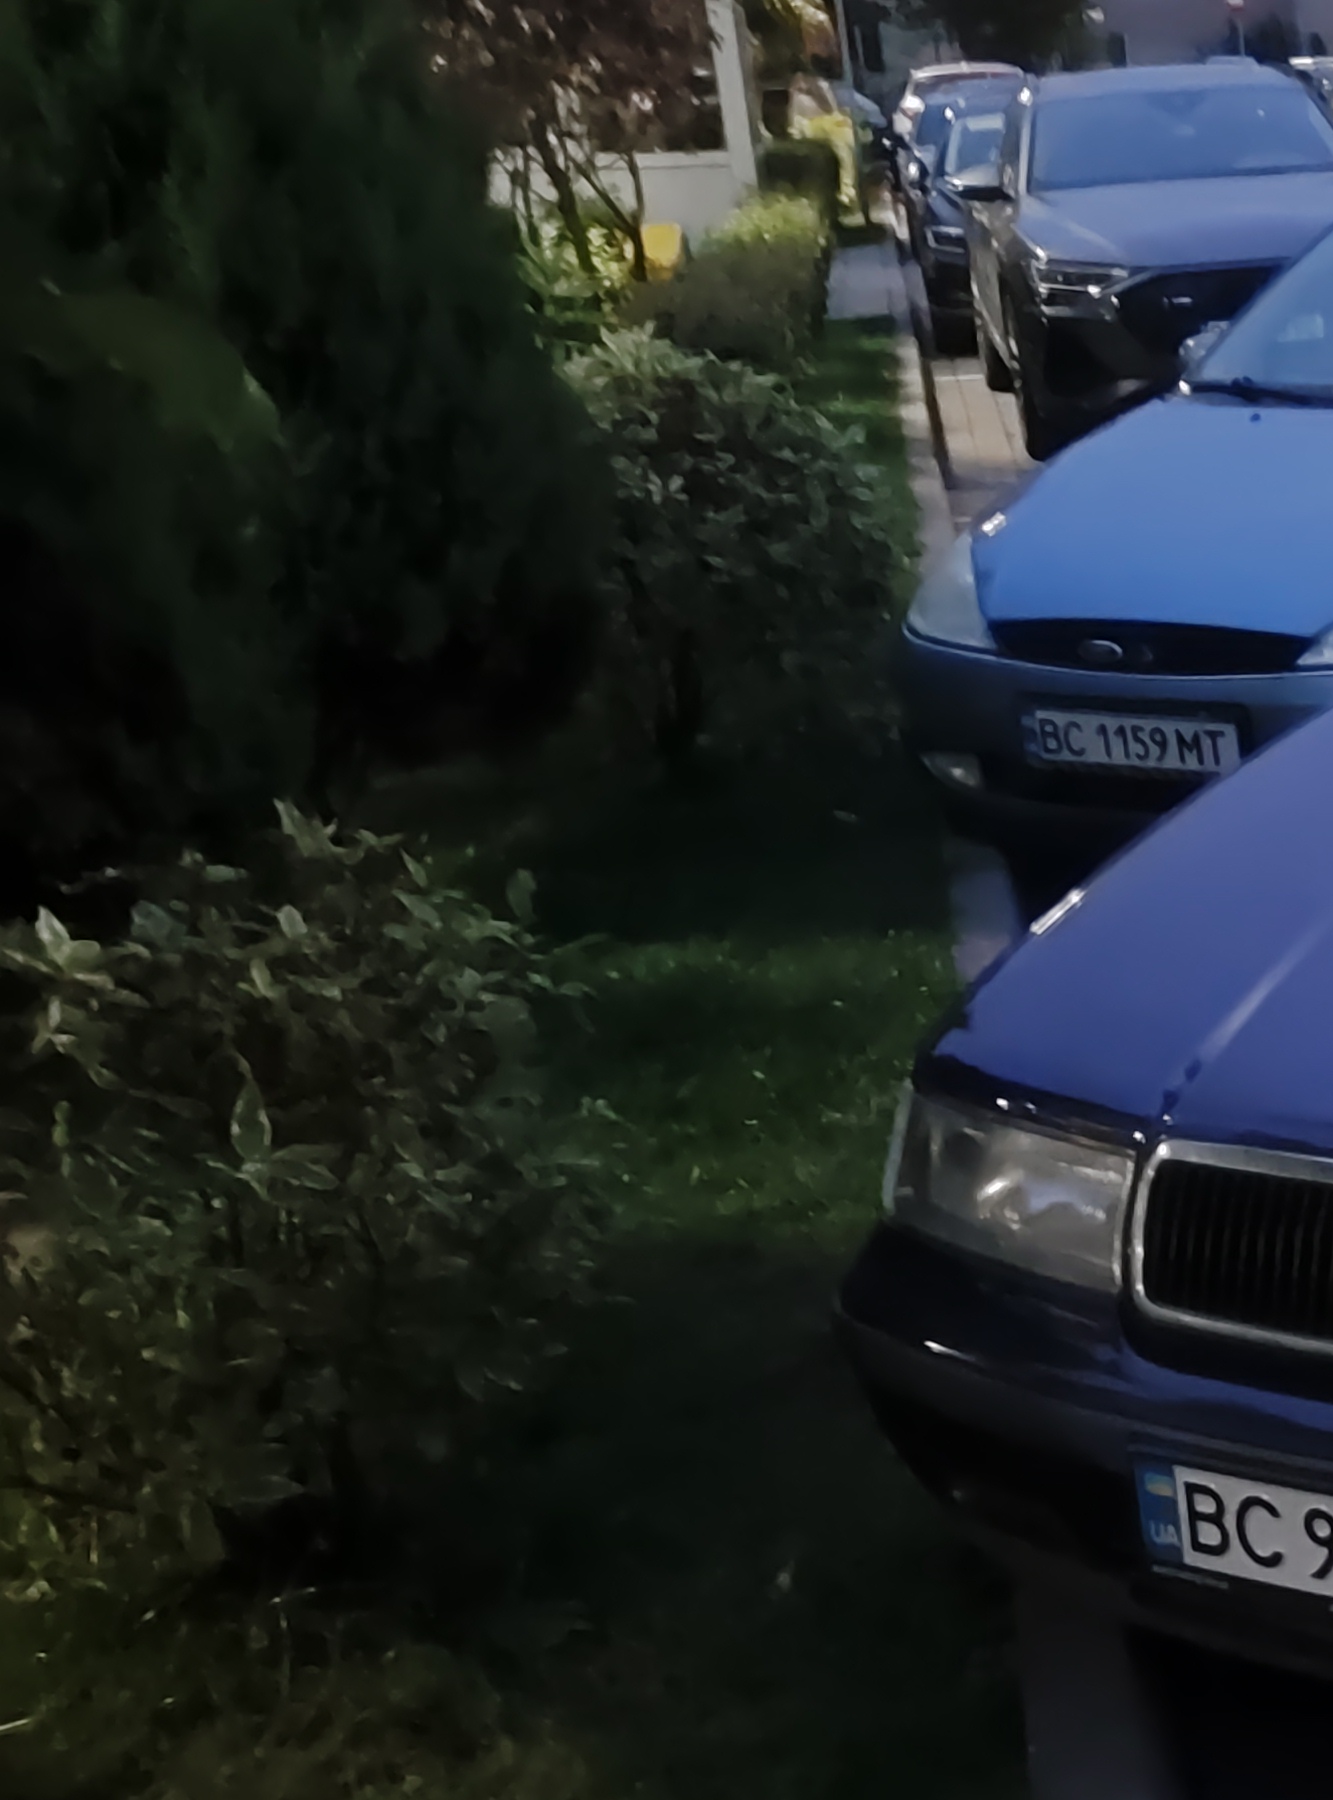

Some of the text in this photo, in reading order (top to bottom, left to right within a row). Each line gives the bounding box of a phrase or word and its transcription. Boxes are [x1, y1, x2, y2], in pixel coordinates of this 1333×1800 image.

[1038, 718, 1226, 767] BC 1159 MT
[1149, 1520, 1181, 1548] UA
[1184, 1480, 1283, 1568] BC
